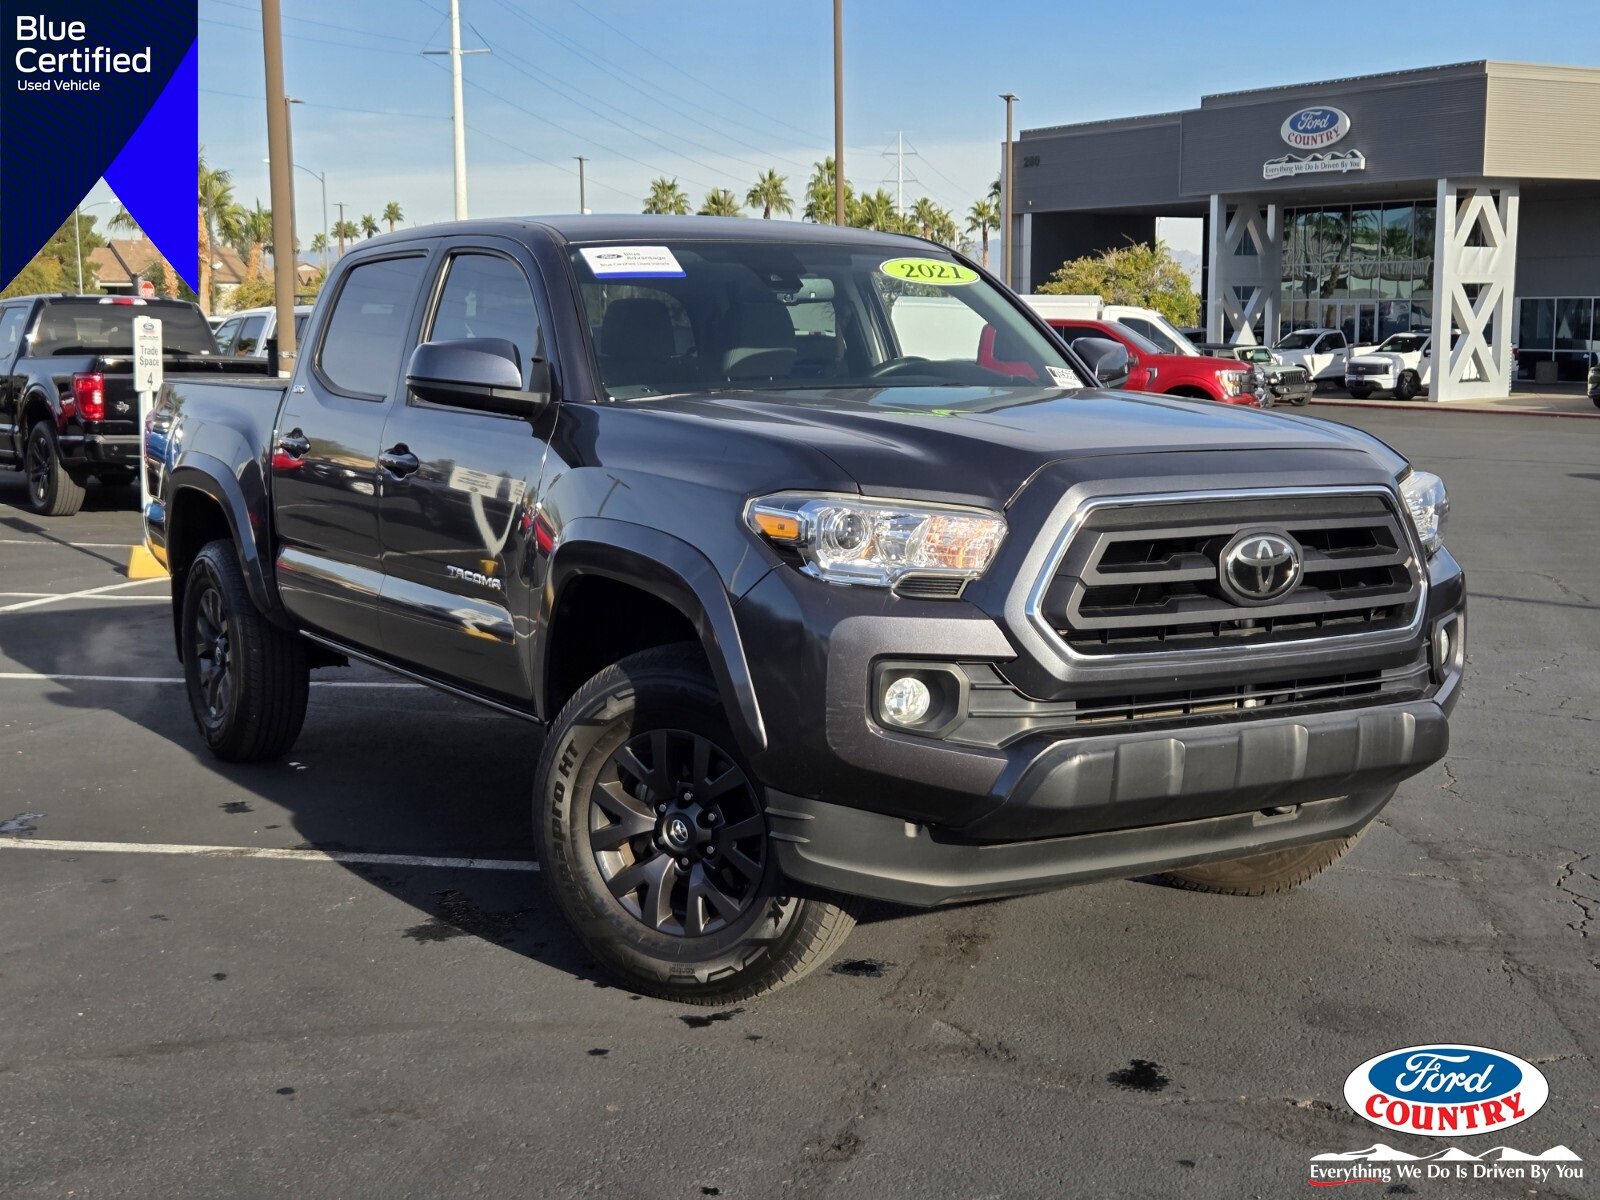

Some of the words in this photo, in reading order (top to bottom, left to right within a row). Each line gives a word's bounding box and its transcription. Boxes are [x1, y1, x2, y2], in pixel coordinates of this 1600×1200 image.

[1297, 110, 1330, 130] Ford
[1287, 126, 1341, 146] COUNTRY
[1265, 164, 1294, 174] Everything
[1320, 161, 1339, 170] Driven
[1341, 160, 1348, 169] By
[1349, 160, 1360, 168] You
[901, 263, 964, 279] 2021
[140, 345, 159, 356] Trade
[139, 356, 160, 368] Space
[147, 372, 153, 386] 4
[447, 565, 501, 590] TACOMA
[558, 739, 579, 778] HT
